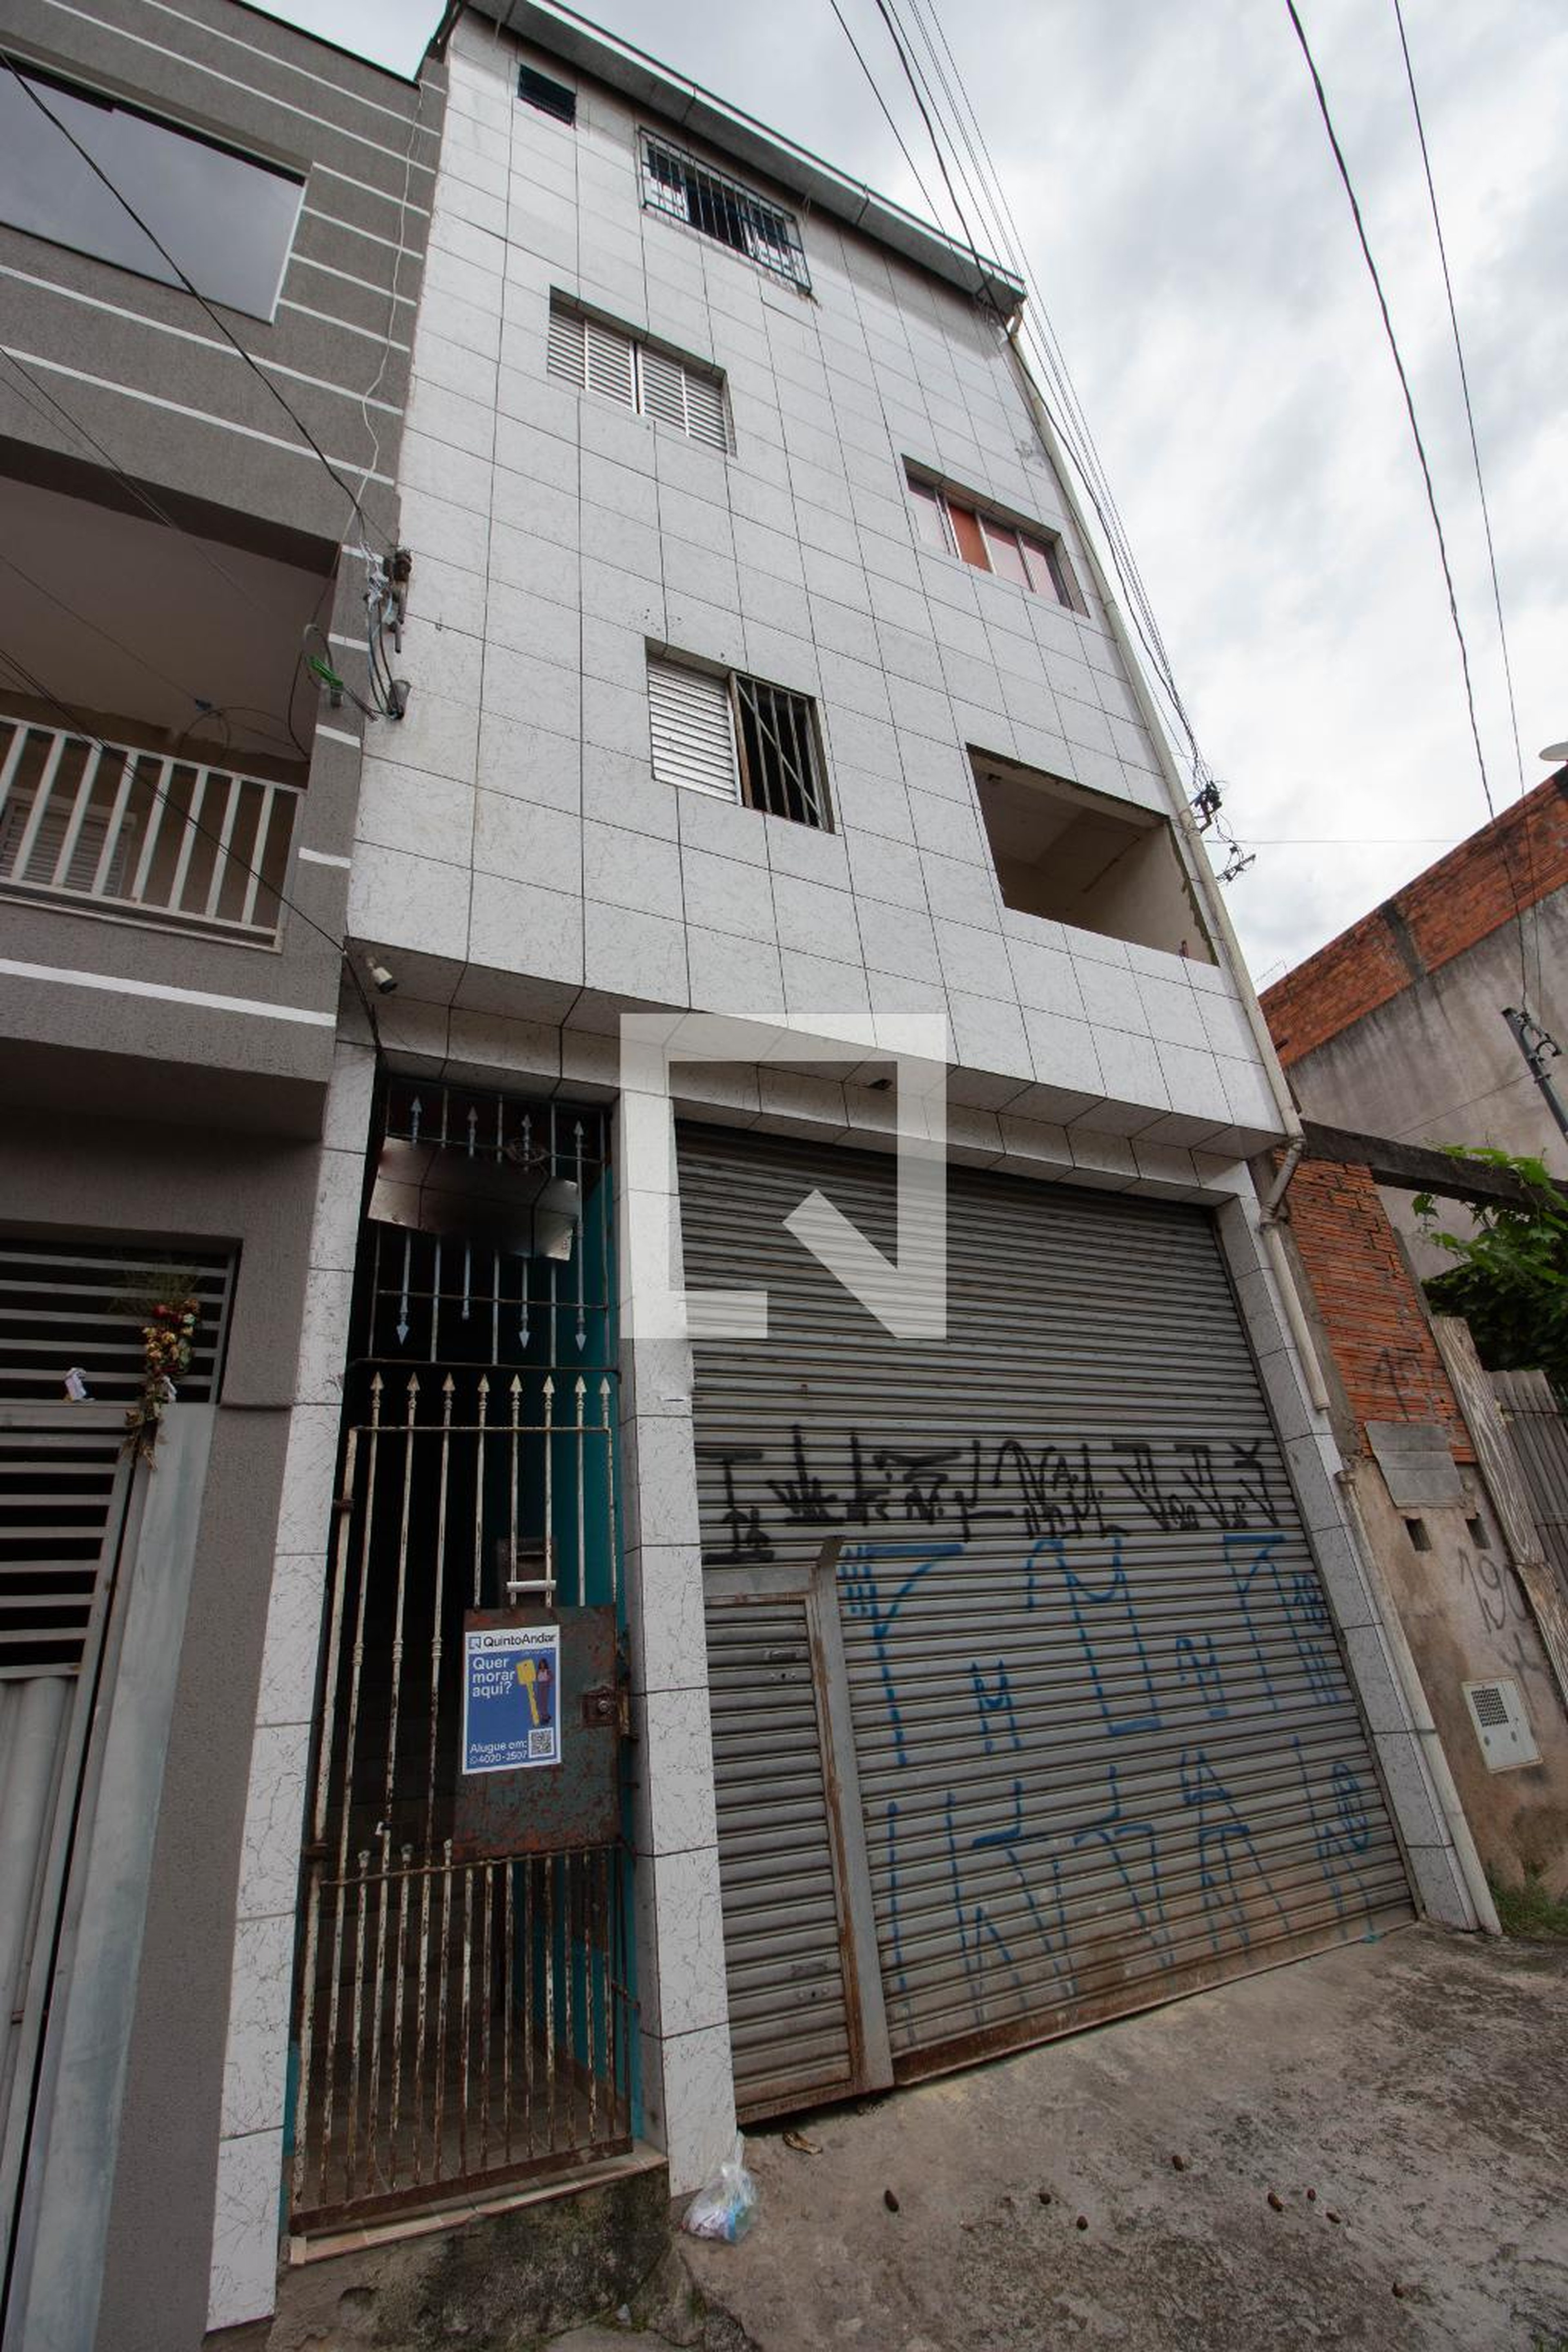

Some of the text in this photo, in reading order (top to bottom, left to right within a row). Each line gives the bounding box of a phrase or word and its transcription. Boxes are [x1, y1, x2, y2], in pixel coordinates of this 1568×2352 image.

[483, 1634, 555, 1648] QuintoAndar
[473, 1657, 509, 1670] Quer
[472, 1670, 515, 1684] morar
[472, 1681, 511, 1699] aqui?
[470, 1743, 506, 1754] Alugue
